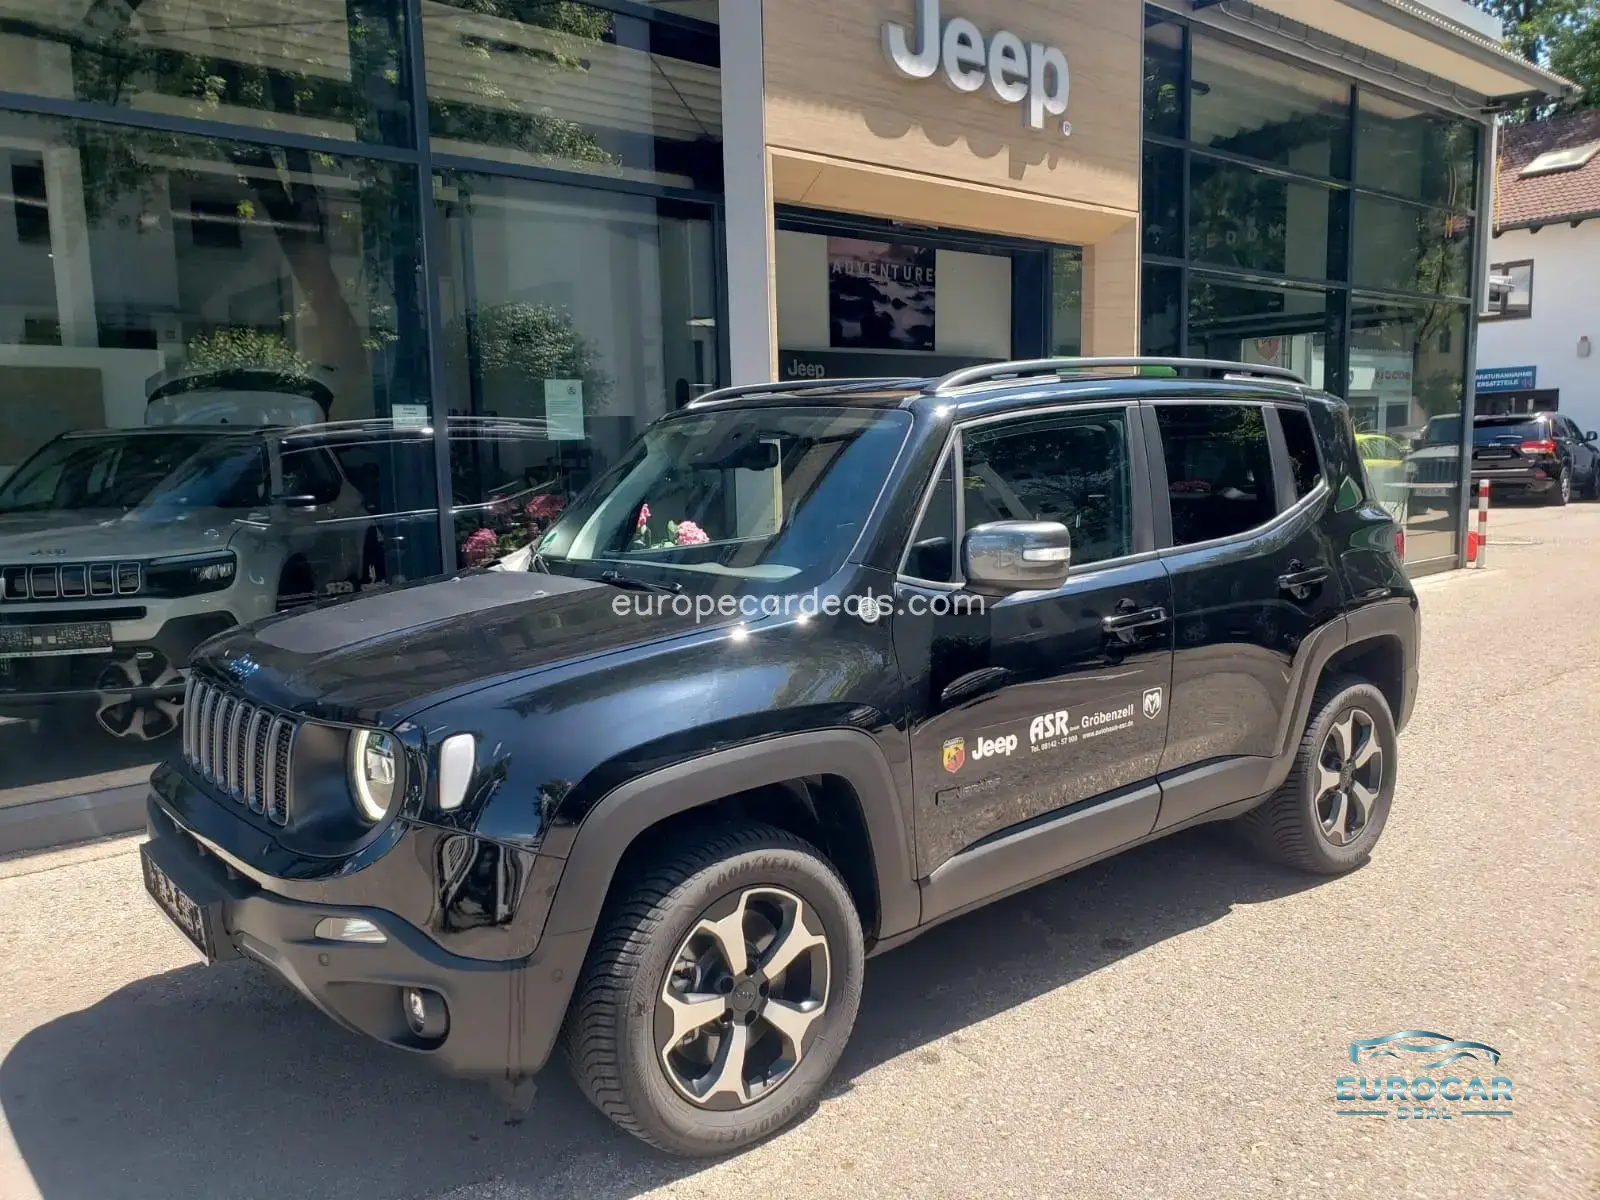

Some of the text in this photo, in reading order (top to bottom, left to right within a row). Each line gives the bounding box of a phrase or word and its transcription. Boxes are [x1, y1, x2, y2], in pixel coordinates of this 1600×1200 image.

[882, 0, 1070, 129] Jeep
[831, 259, 934, 283] ADVENTURE
[787, 358, 826, 379] Jeep
[1029, 703, 1135, 745] ASR Gröbenzell
[971, 734, 1018, 760] Jeep
